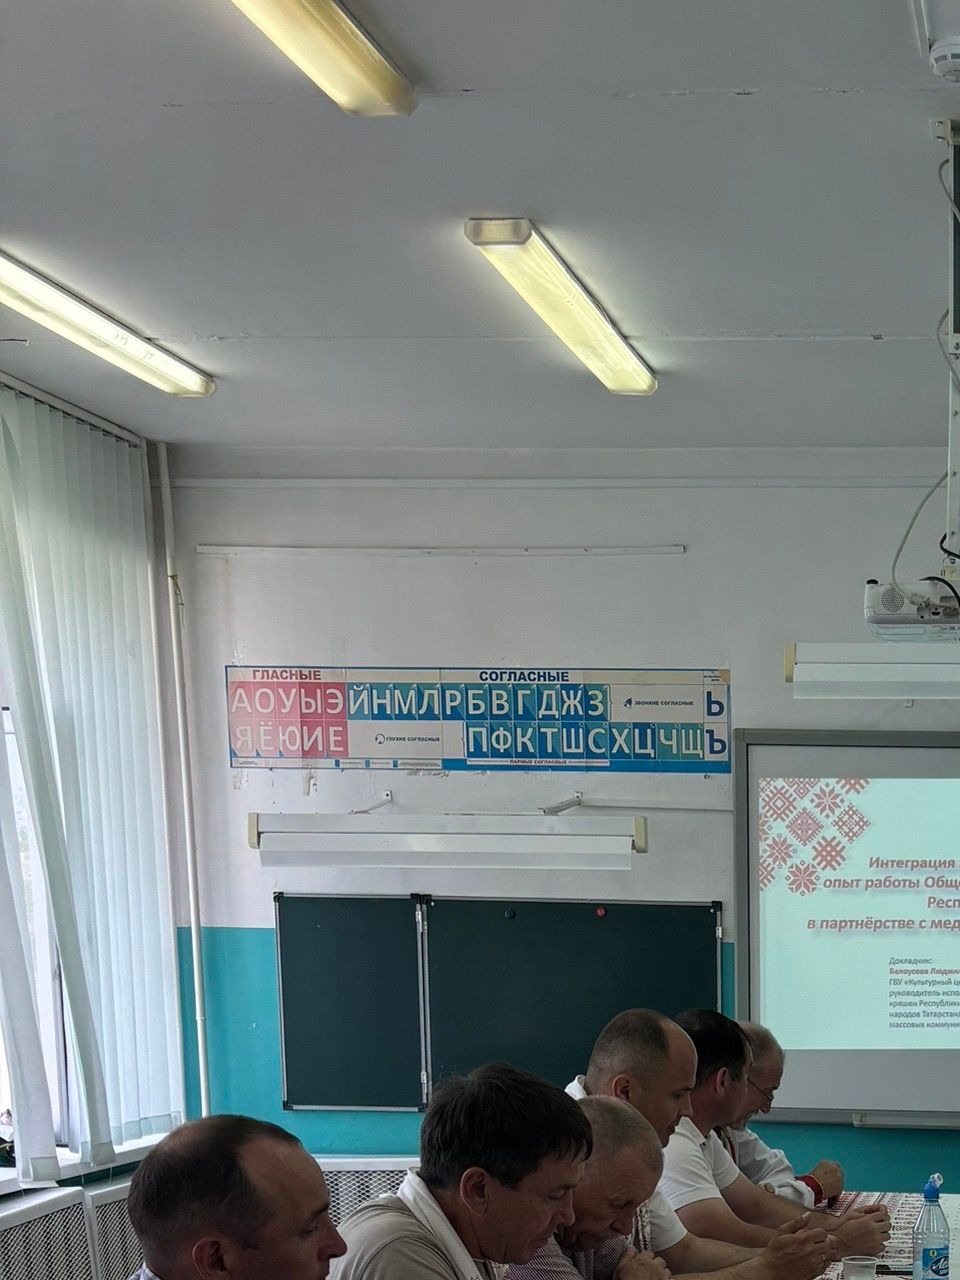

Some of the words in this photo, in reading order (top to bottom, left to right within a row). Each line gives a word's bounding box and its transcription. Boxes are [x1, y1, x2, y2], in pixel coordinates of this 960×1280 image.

[253, 670, 321, 681] ГЛАСНЫЕ
[479, 671, 569, 682] СОГЛАСНЫЕ
[706, 691, 724, 717] Ь
[706, 730, 726, 754] Ъ
[869, 856, 955, 870] Интеграция
[823, 877, 861, 889] опыт
[865, 876, 920, 890] работы
[807, 919, 816, 929] в
[820, 916, 914, 932] партнёрстве
[919, 919, 926, 929] с
[889, 957, 932, 965] Докладчик:
[904, 978, 952, 987] «Культурный
[889, 990, 940, 998] руководитель
